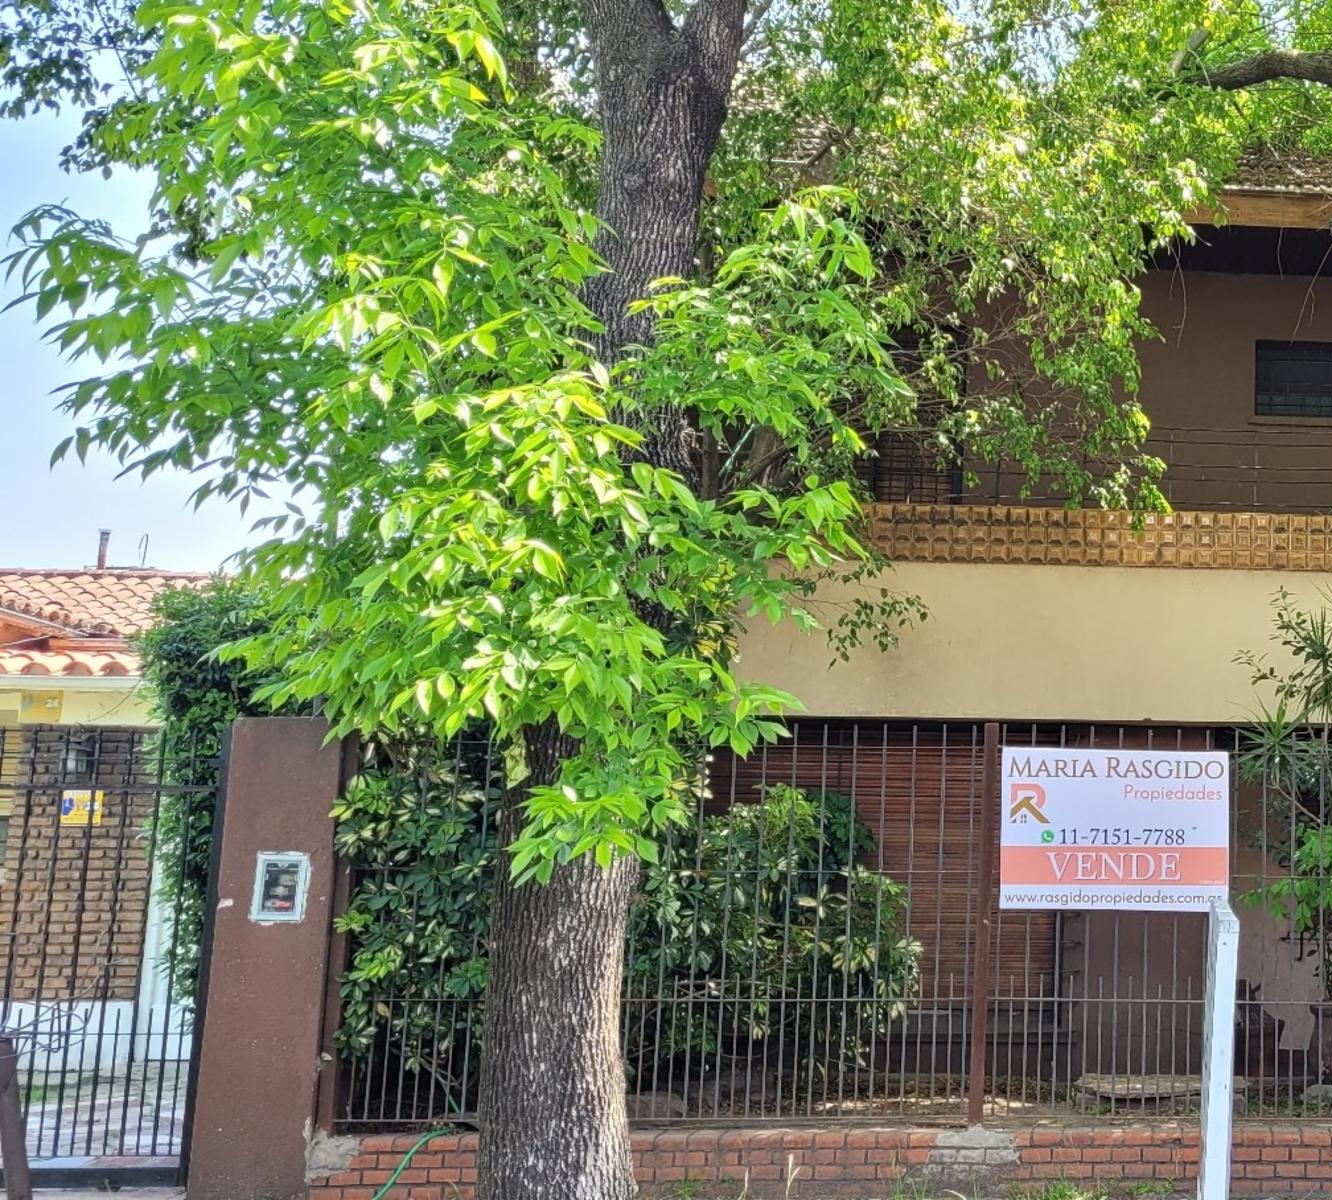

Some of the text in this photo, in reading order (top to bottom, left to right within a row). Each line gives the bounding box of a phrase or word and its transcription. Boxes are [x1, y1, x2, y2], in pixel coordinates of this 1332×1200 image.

[1007, 756, 1225, 780] MARIA RASGIDO
[1123, 784, 1223, 802] Propiedades
[1059, 828, 1186, 845] 11-7151-7788
[1046, 851, 1182, 881] VENDE
